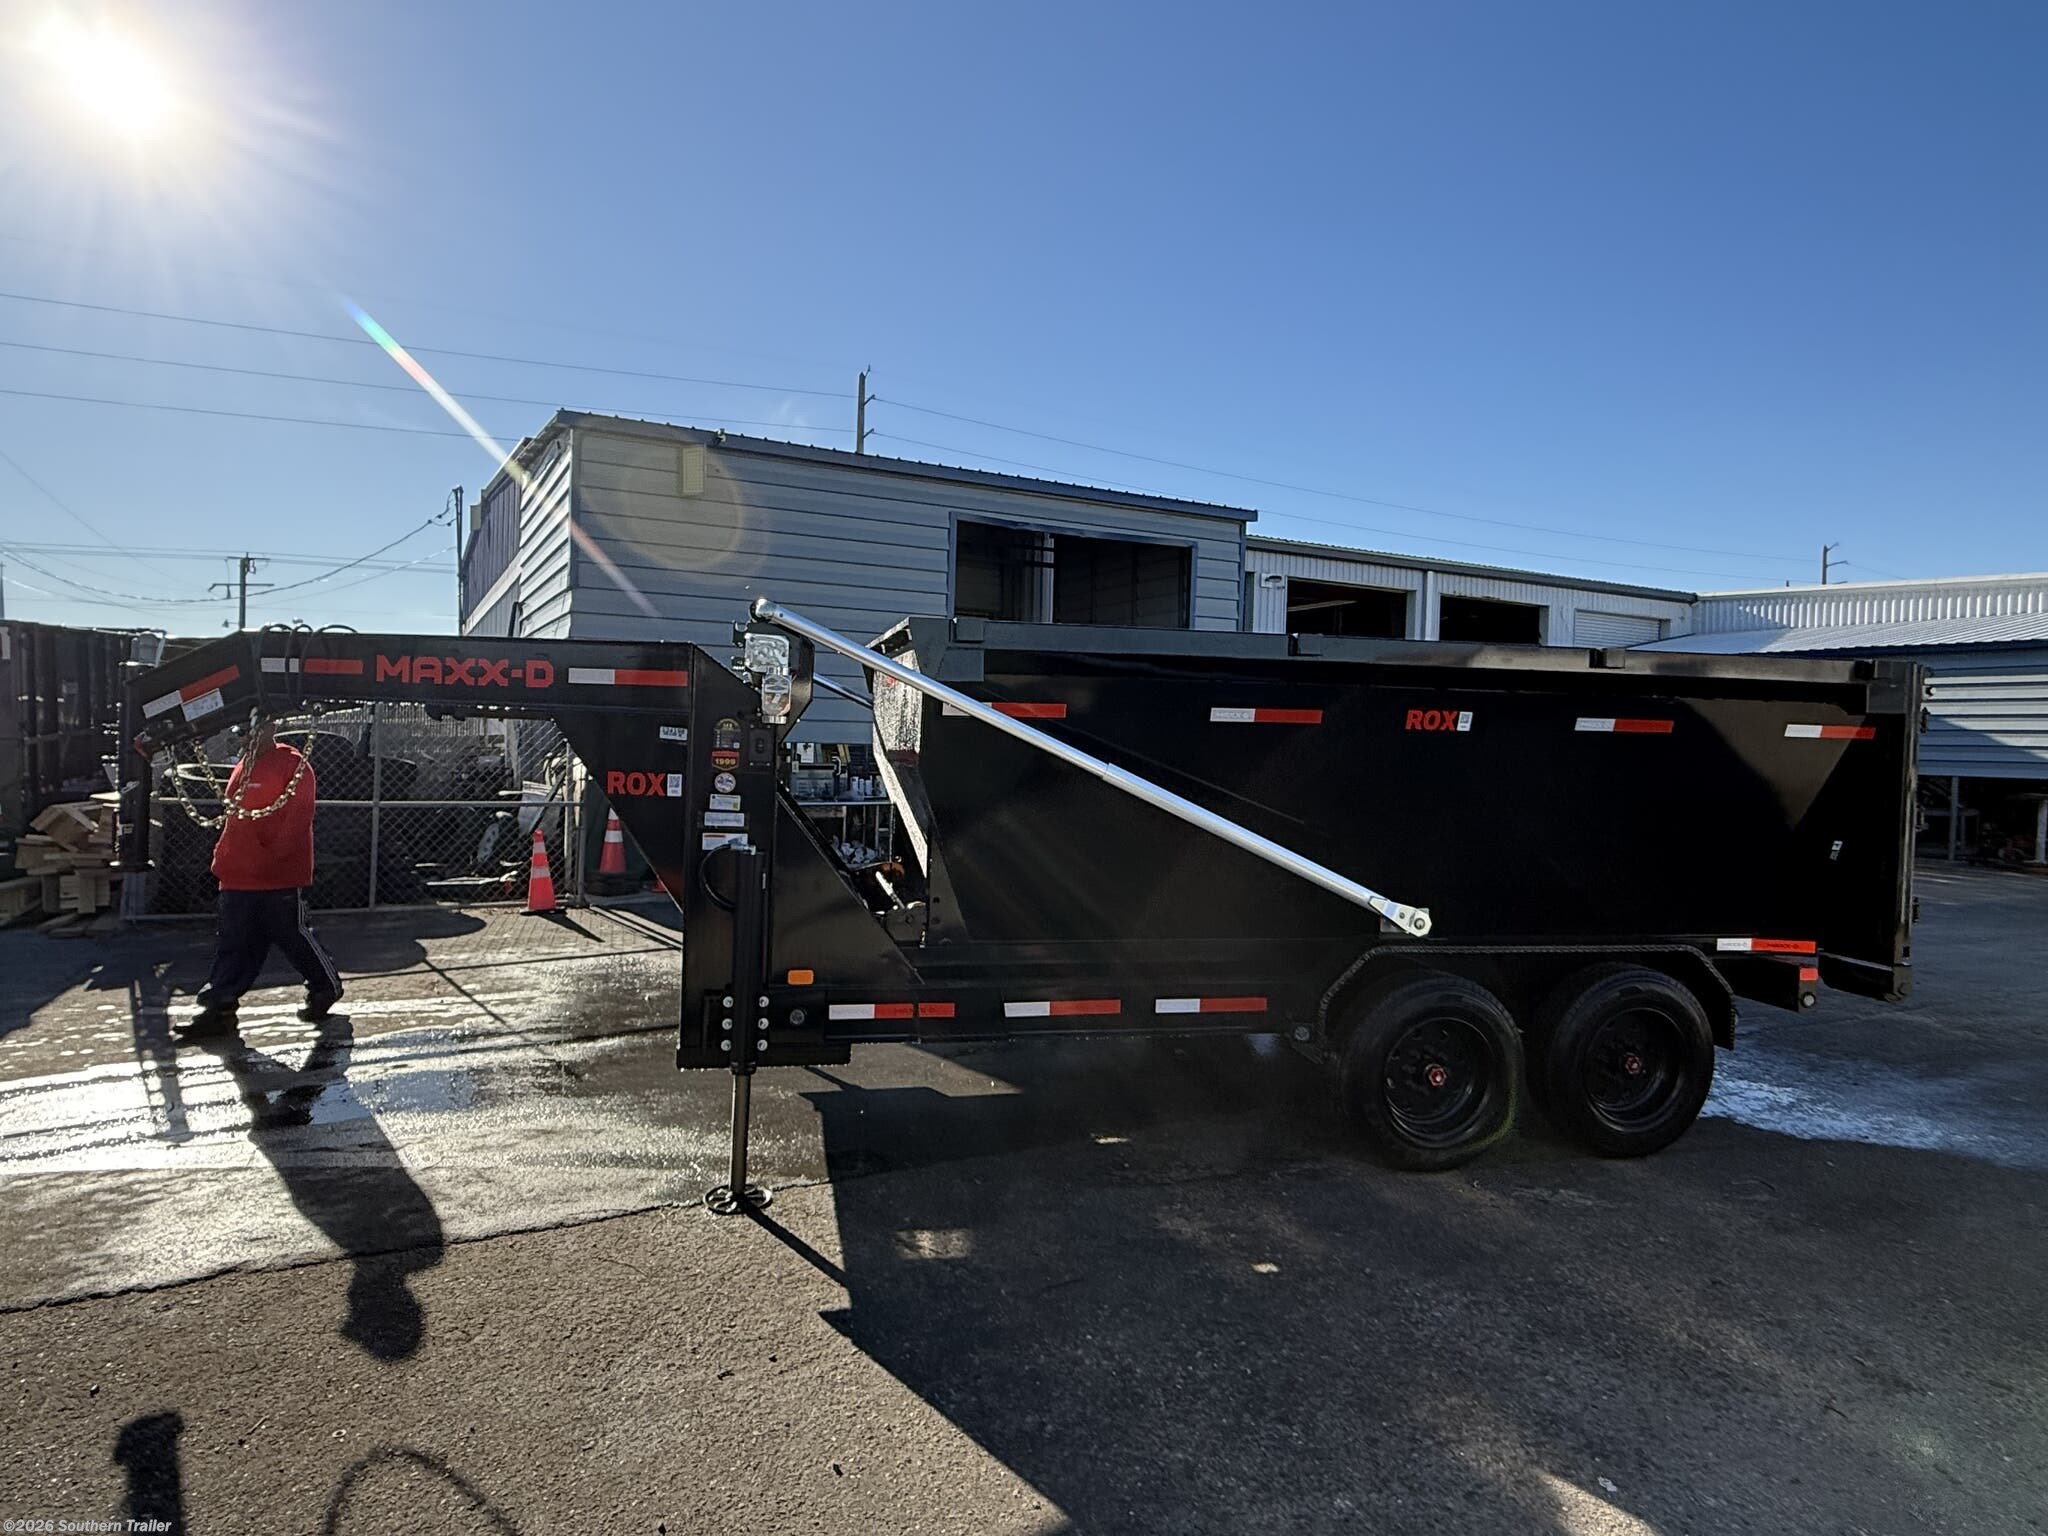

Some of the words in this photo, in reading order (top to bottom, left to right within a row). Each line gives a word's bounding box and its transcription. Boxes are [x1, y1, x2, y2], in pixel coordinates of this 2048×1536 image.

[376, 655, 554, 688] MAXX-D
[1405, 709, 1457, 731] ROX
[607, 770, 666, 797] ROX
